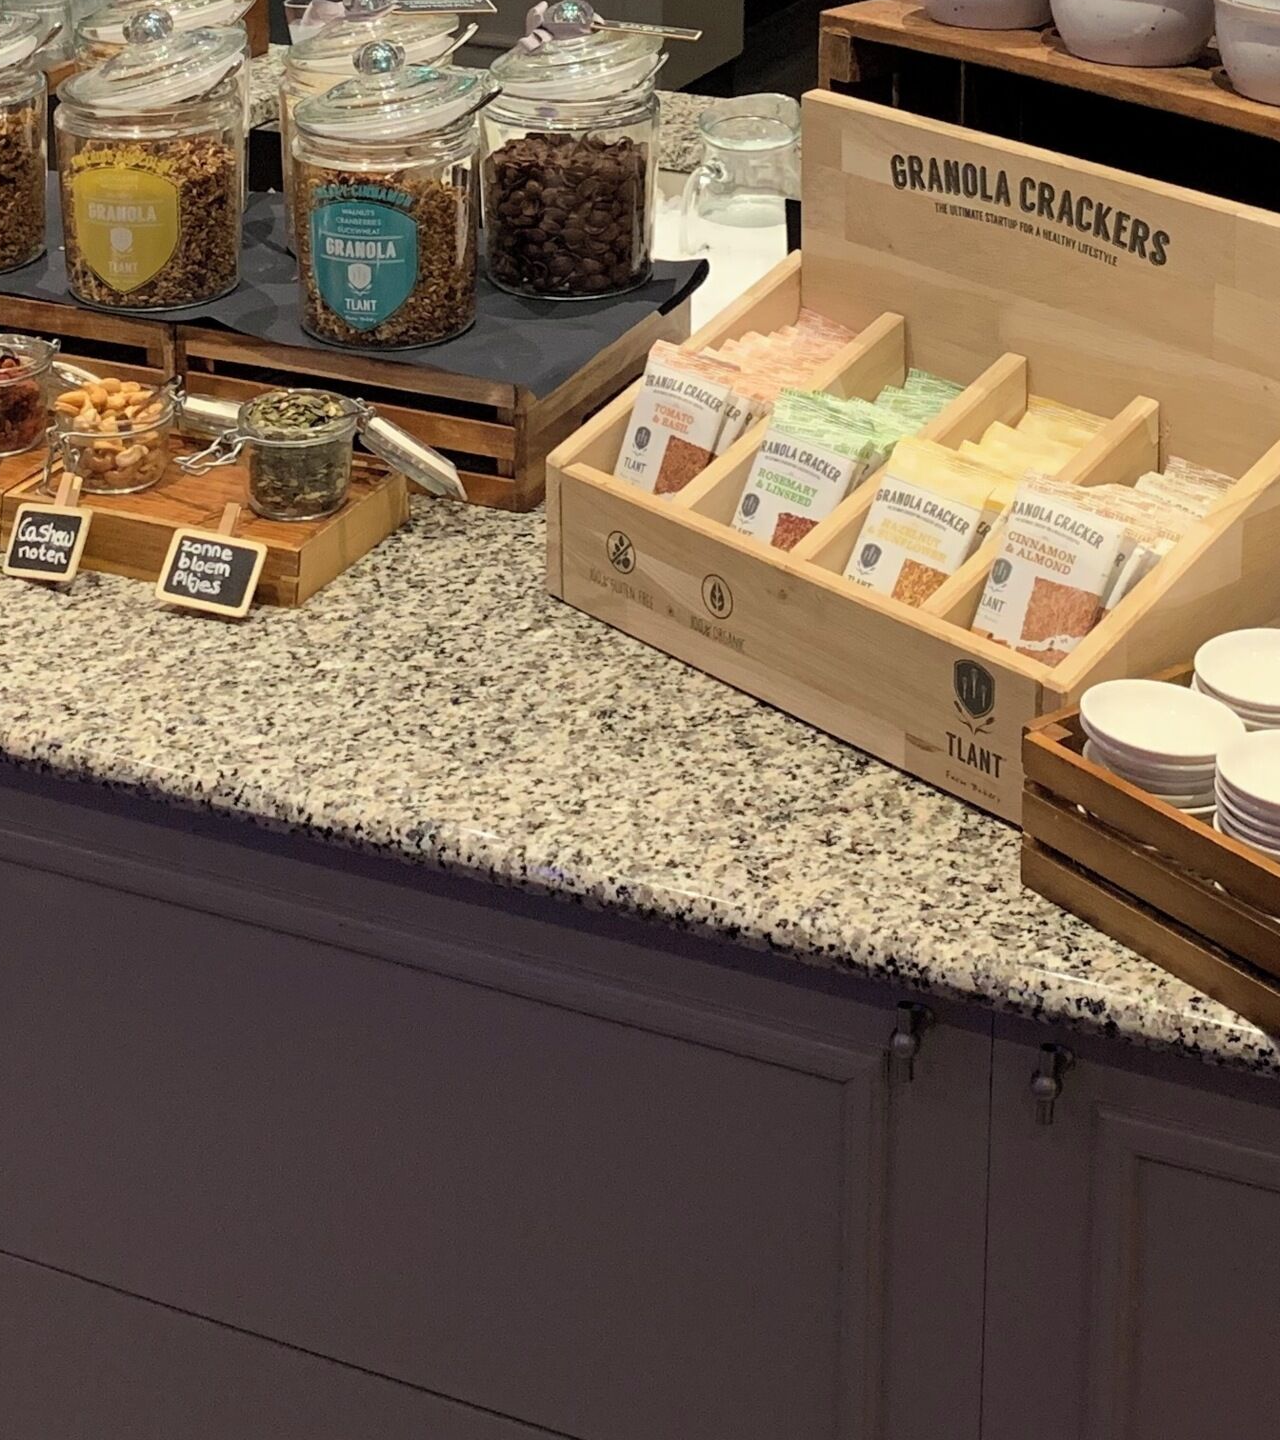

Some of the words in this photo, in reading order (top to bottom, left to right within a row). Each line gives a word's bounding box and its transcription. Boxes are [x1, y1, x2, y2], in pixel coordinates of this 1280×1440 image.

[89, 202, 156, 222] GRANOLA
[336, 218, 381, 226] CRANBERRIES
[890, 154, 1011, 207] GRANOLA
[1020, 176, 1170, 266] CRACKERS
[326, 237, 396, 258] GRANOLA
[935, 203, 948, 214] THE
[950, 205, 983, 222] ULTIMATE
[985, 213, 1018, 229] STARTUP
[1020, 222, 1033, 235] FOR
[1035, 226, 1040, 236] A
[1043, 229, 1076, 249] HEALTHY
[1078, 242, 1117, 267] LIFESTYLE
[109, 261, 137, 273] TLANT
[344, 298, 377, 310] TLANT
[683, 384, 723, 413] CRACKER
[652, 414, 659, 422] &
[662, 417, 689, 434] BASIL
[655, 404, 694, 424] TOMATO
[624, 456, 647, 473] TLANT
[798, 451, 842, 483] CRACKER
[755, 480, 763, 488] &
[764, 483, 812, 508] LINSEED
[758, 468, 818, 497] ROSEMARY
[876, 488, 922, 511] GRANOLA
[923, 501, 970, 536] CRACKER
[1054, 514, 1104, 549] CRACKER
[19, 545, 67, 564] noten
[181, 540, 232, 561] zonne
[1005, 543, 1014, 553] &
[1018, 547, 1071, 576] ALMOND
[1008, 531, 1076, 565] CINNAMON
[178, 552, 230, 577] bloem
[946, 731, 1003, 778] TLANT
